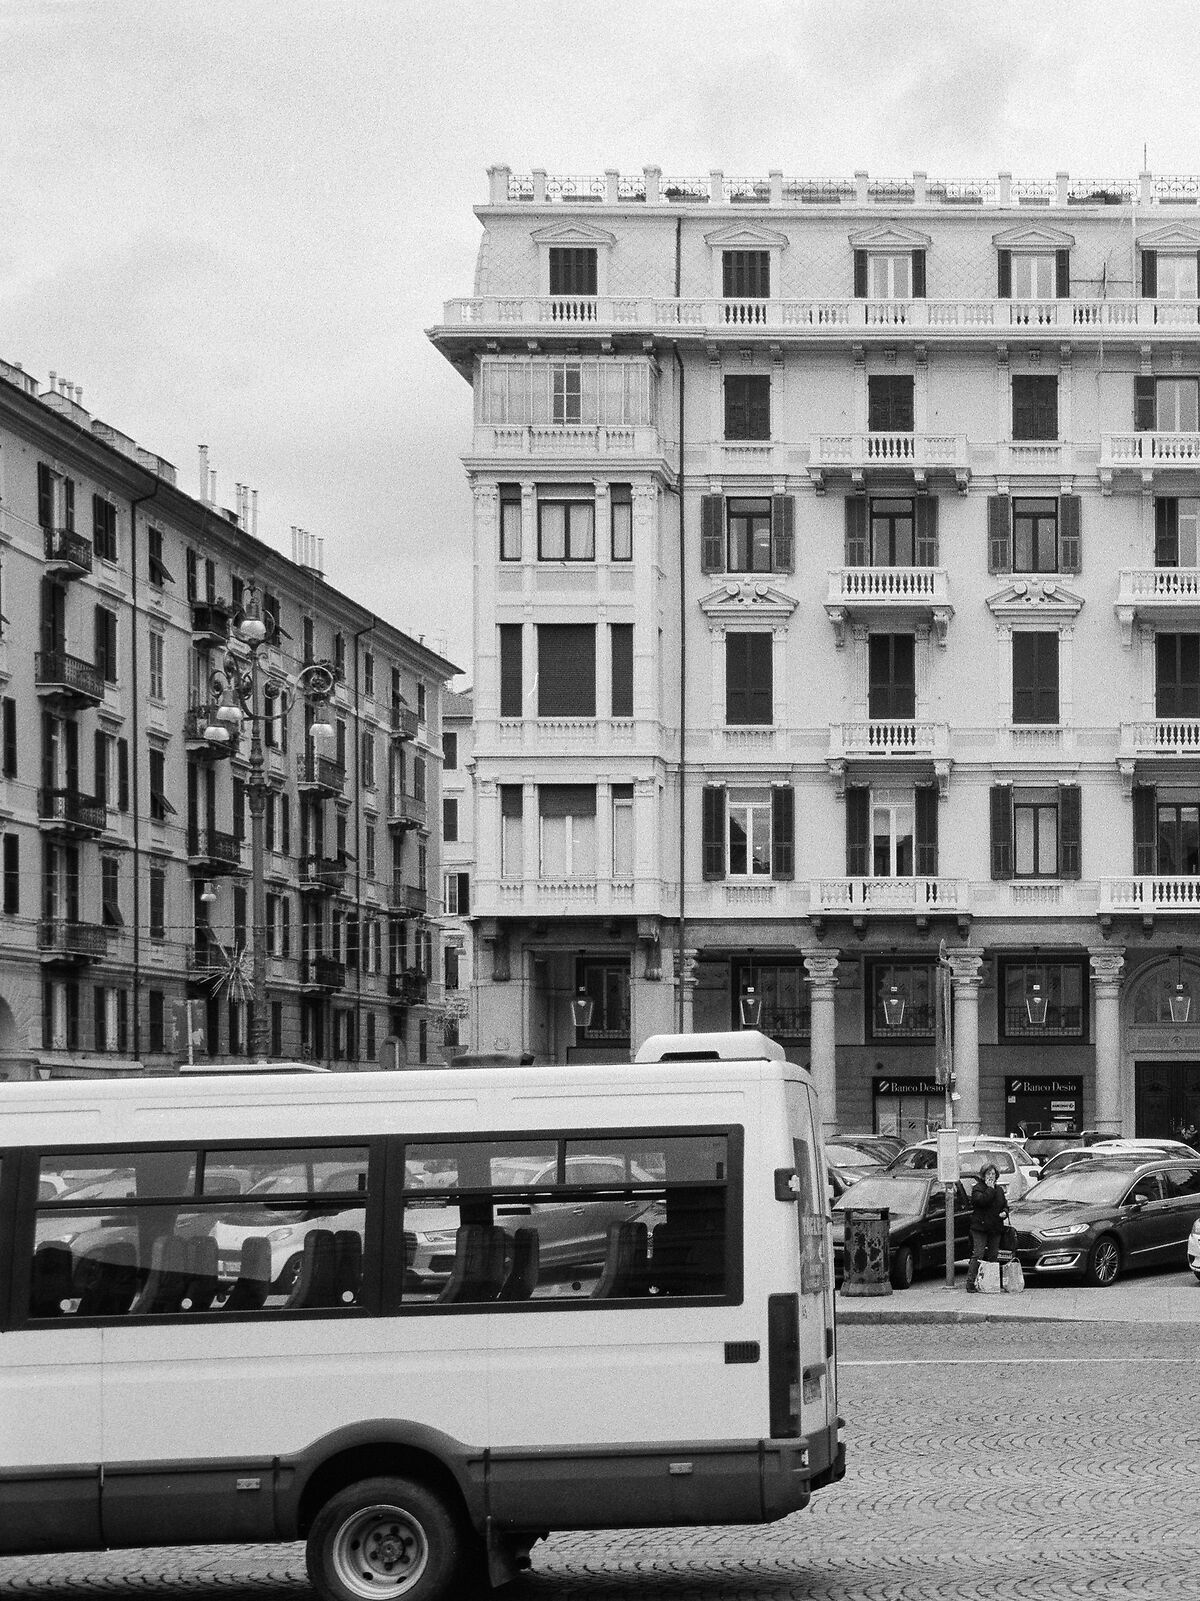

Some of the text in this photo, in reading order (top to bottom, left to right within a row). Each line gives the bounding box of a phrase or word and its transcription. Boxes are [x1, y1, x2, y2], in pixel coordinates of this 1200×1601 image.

[891, 1082, 944, 1093] Banco Desio
[1023, 1080, 1076, 1092] Banco Desio
